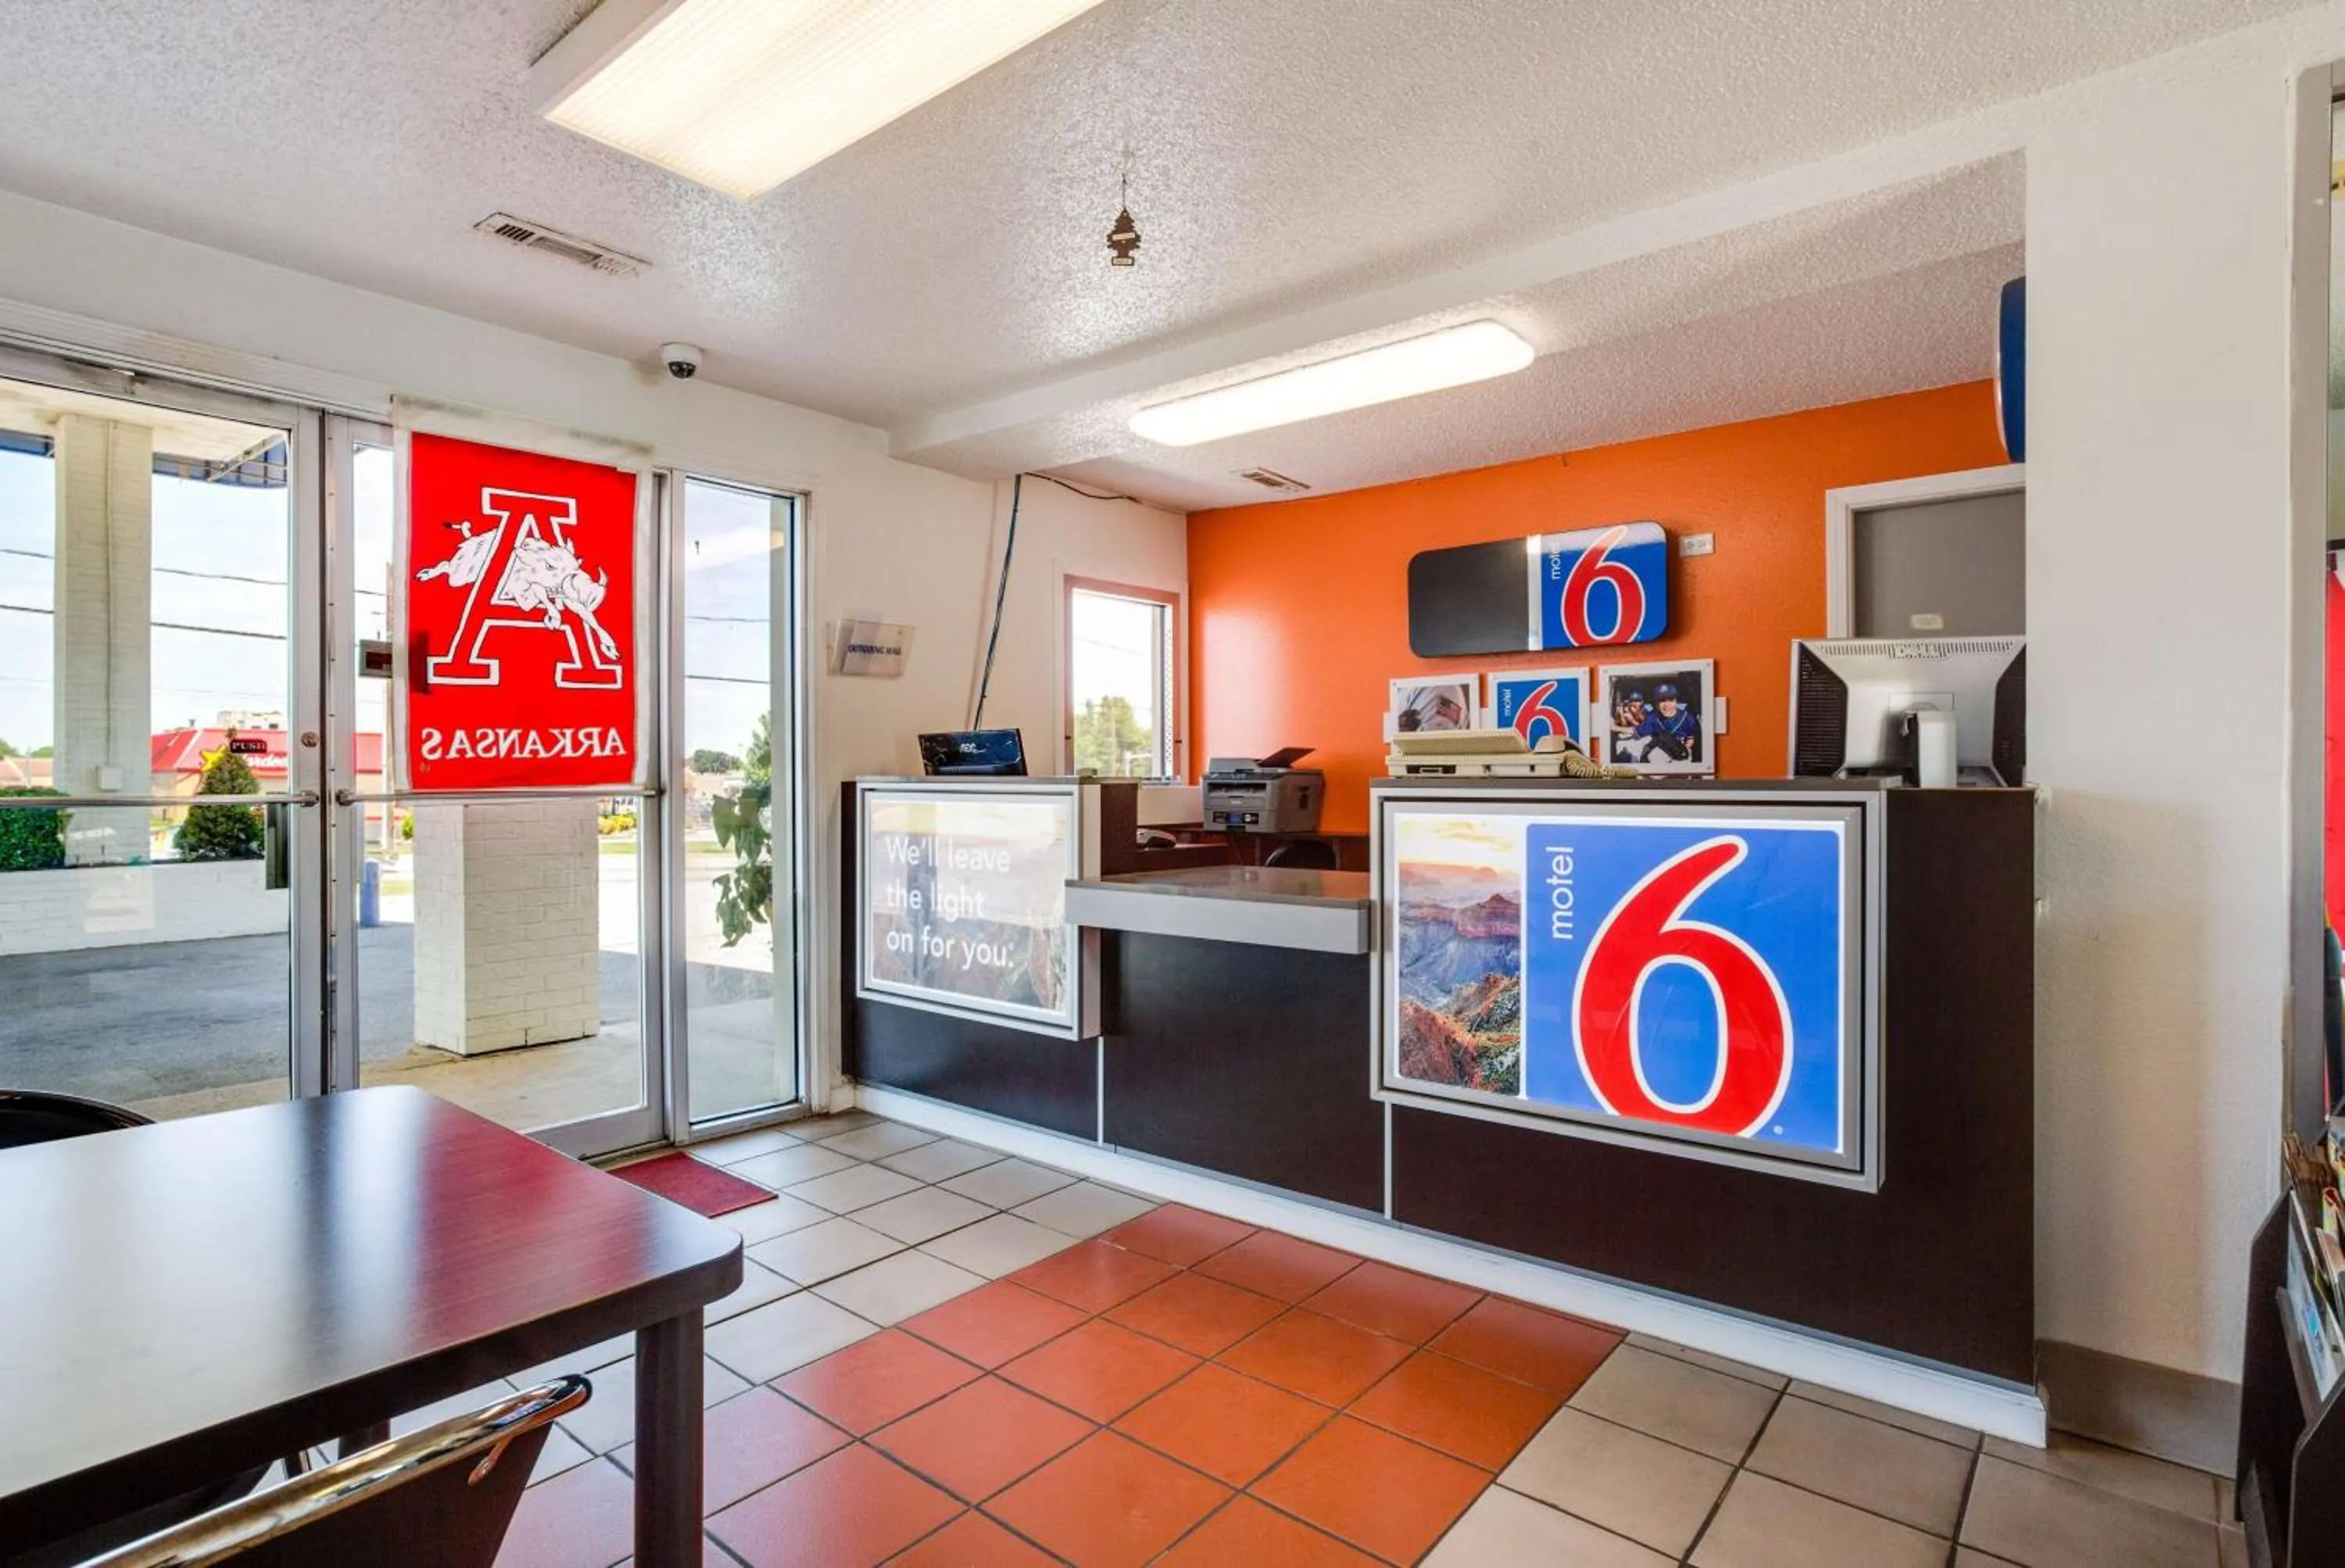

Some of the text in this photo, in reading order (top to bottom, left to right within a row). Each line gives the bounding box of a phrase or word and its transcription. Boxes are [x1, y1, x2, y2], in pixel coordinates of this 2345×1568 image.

[1559, 524, 1646, 647] 6
[1502, 680, 1570, 750] motel 6
[232, 741, 266, 750] PUSH
[886, 835, 1011, 872] We'll leave
[886, 878, 985, 923] the light
[886, 929, 914, 954] on
[921, 925, 955, 959] for
[1545, 834, 1795, 1138] motel 6
